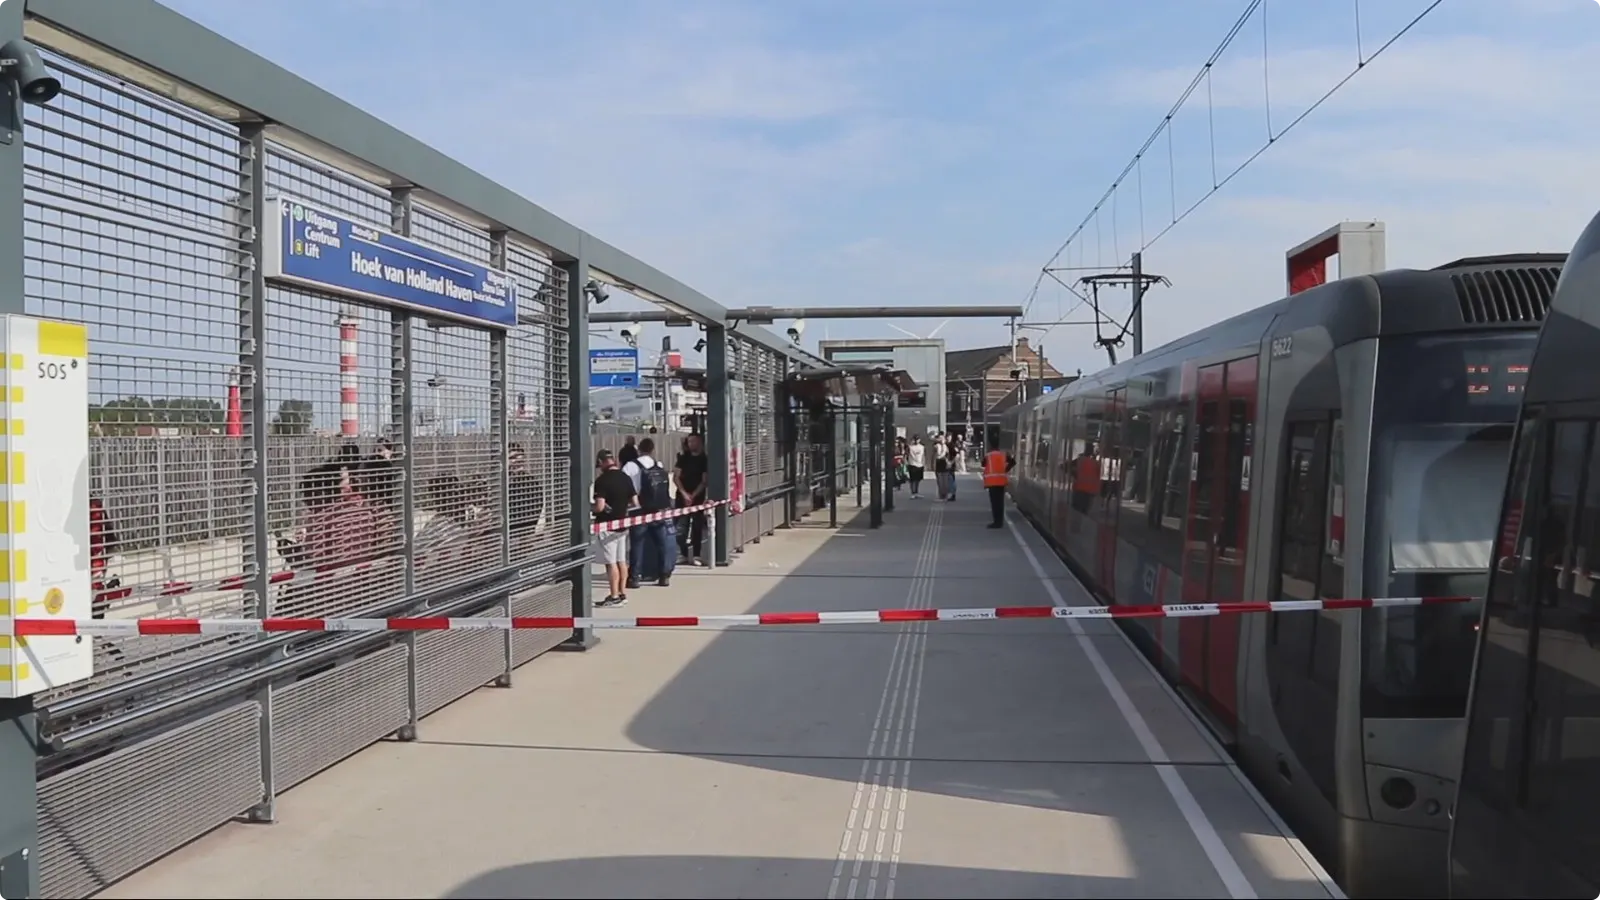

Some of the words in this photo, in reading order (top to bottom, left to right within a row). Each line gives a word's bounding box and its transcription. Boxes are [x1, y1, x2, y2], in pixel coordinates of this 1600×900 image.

[304, 208, 338, 234] Uitgang
[304, 226, 341, 249] Centrum
[304, 242, 320, 259] Lift
[351, 250, 382, 279] Hoek
[384, 264, 405, 284] van
[406, 267, 444, 295] Holland
[445, 279, 473, 303] Haven
[38, 361, 67, 380] SOS
